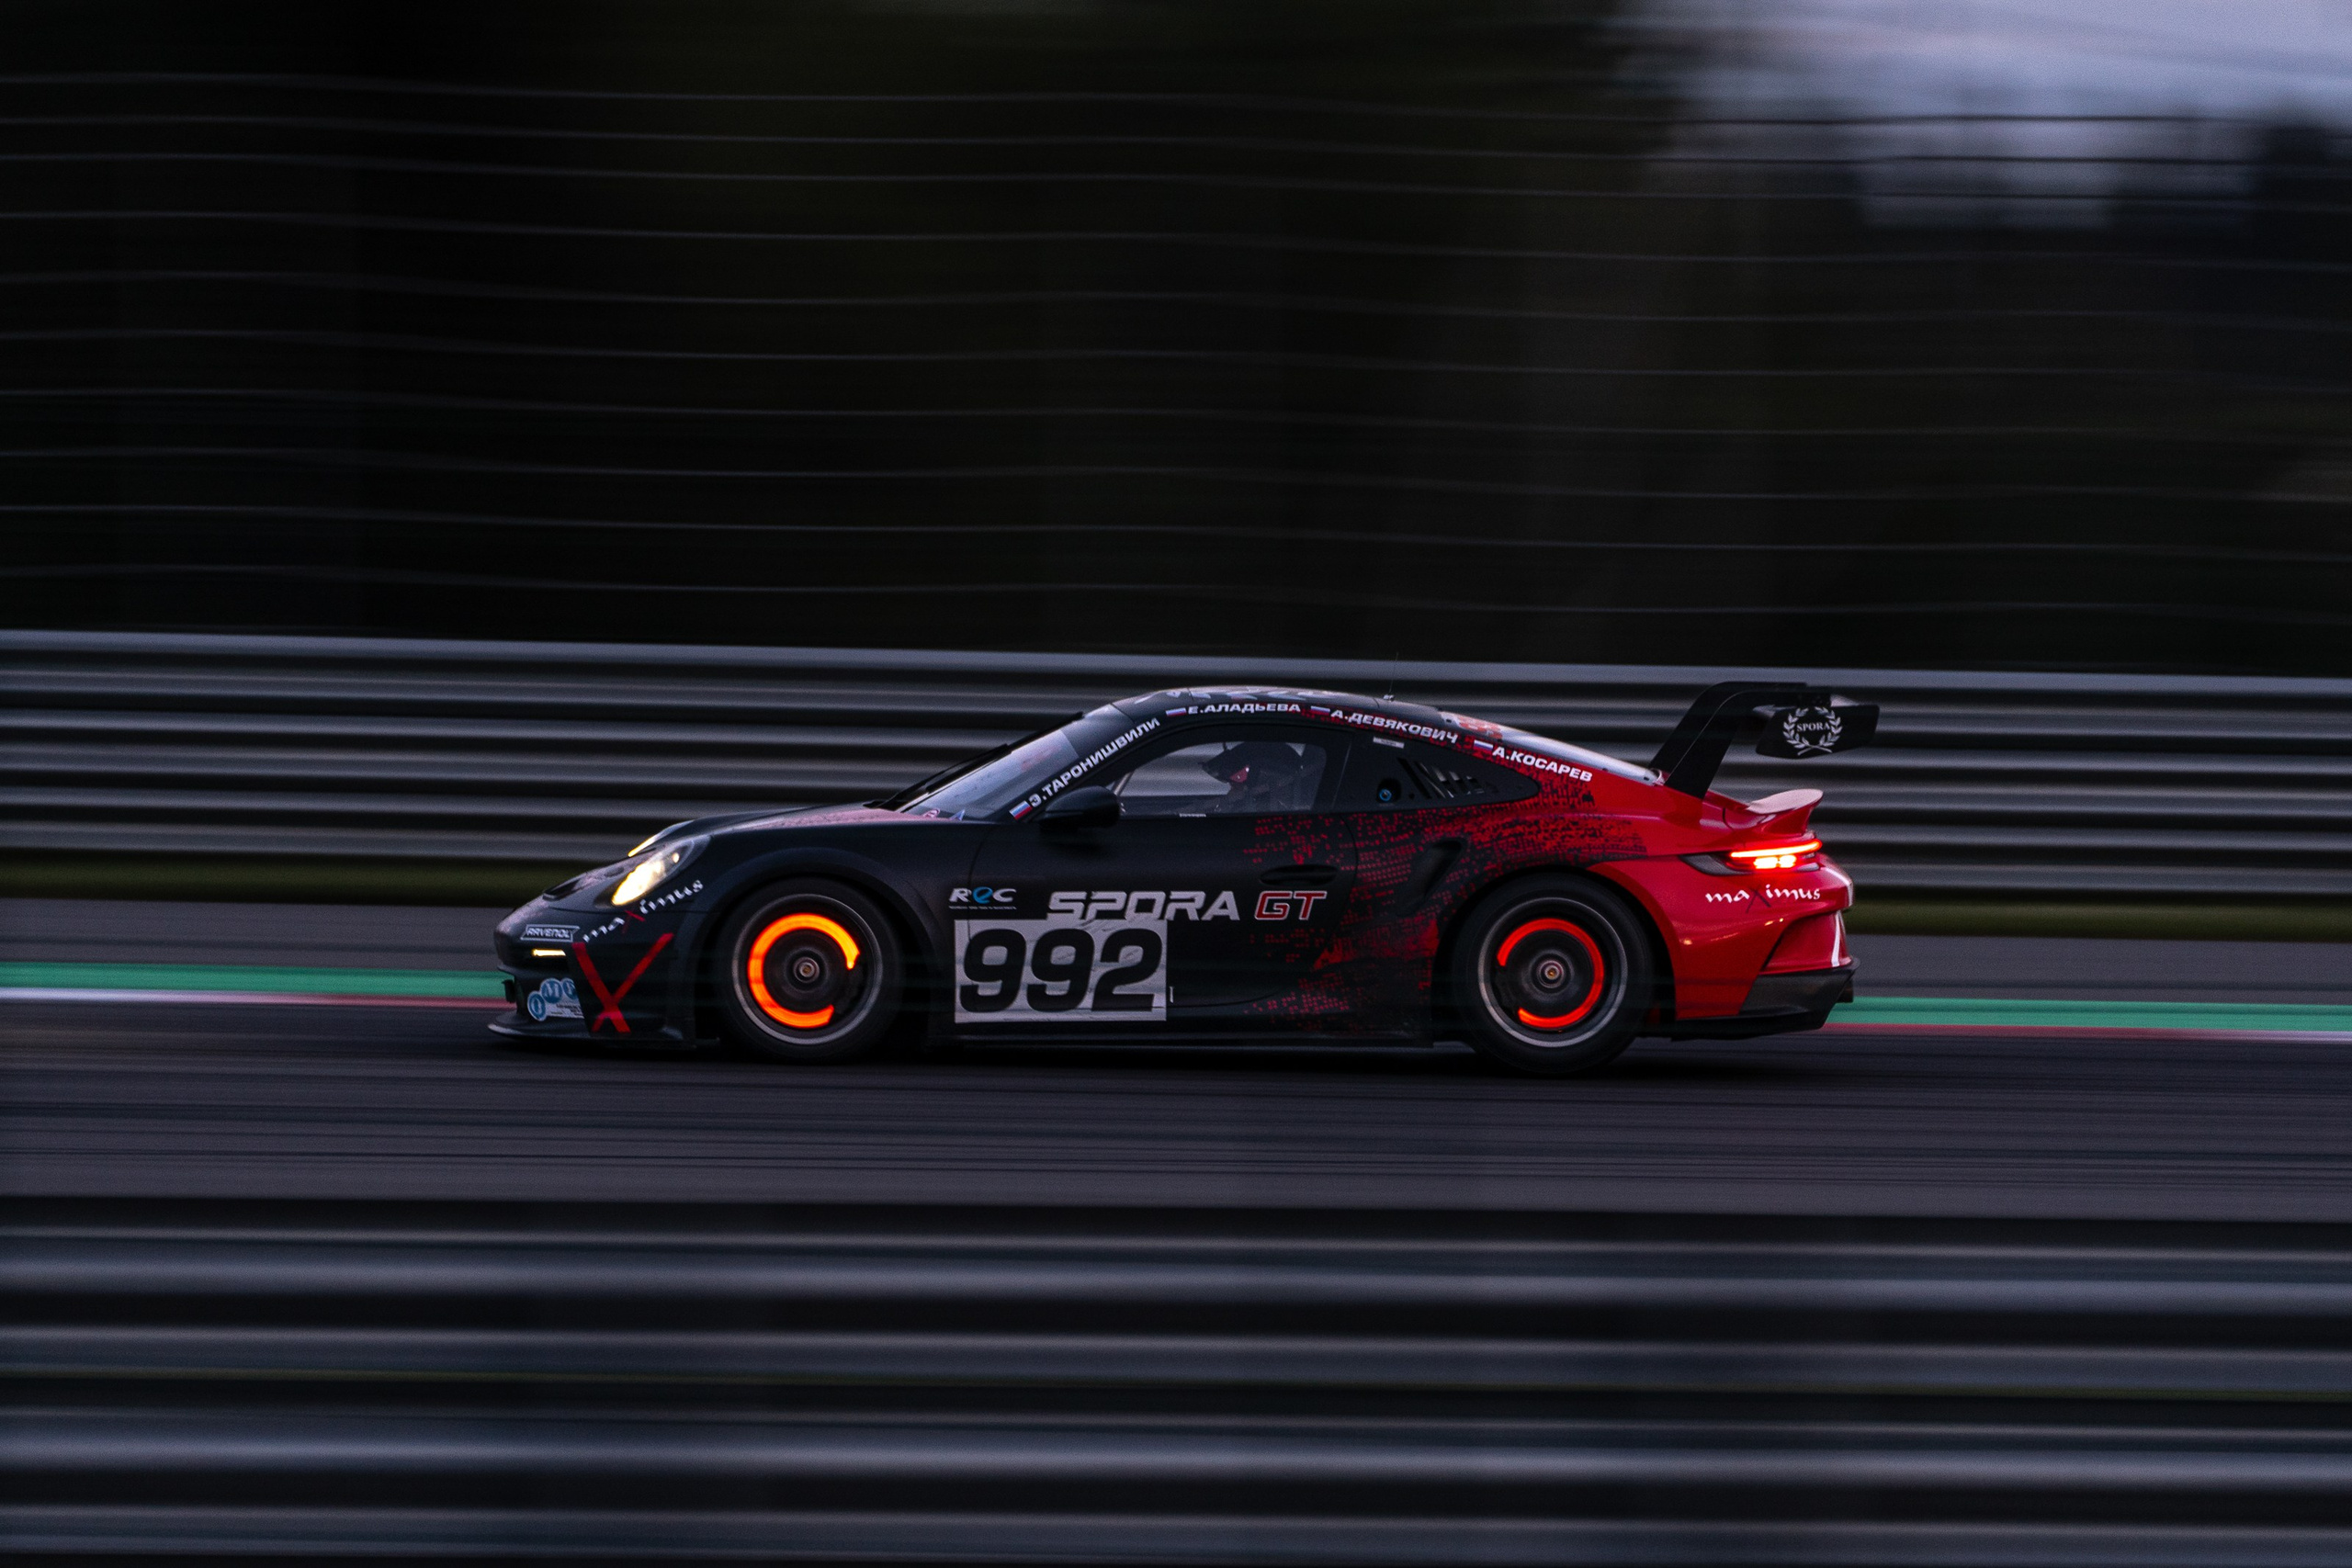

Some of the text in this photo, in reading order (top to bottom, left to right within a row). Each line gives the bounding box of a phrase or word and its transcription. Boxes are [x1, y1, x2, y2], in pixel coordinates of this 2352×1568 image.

[1188, 703, 1301, 715] Е.АЛАДЬЕВА
[1330, 709, 1458, 744] А.ДЕВЯКОВИЧ
[1796, 721, 1832, 732] SPORA
[1028, 717, 1160, 807] Э.ТАРОНИШВИЛИ
[1492, 746, 1593, 783] А.КОСАРЕВ
[1046, 890, 1328, 920] SPORA GT
[960, 929, 1162, 1012] 992
